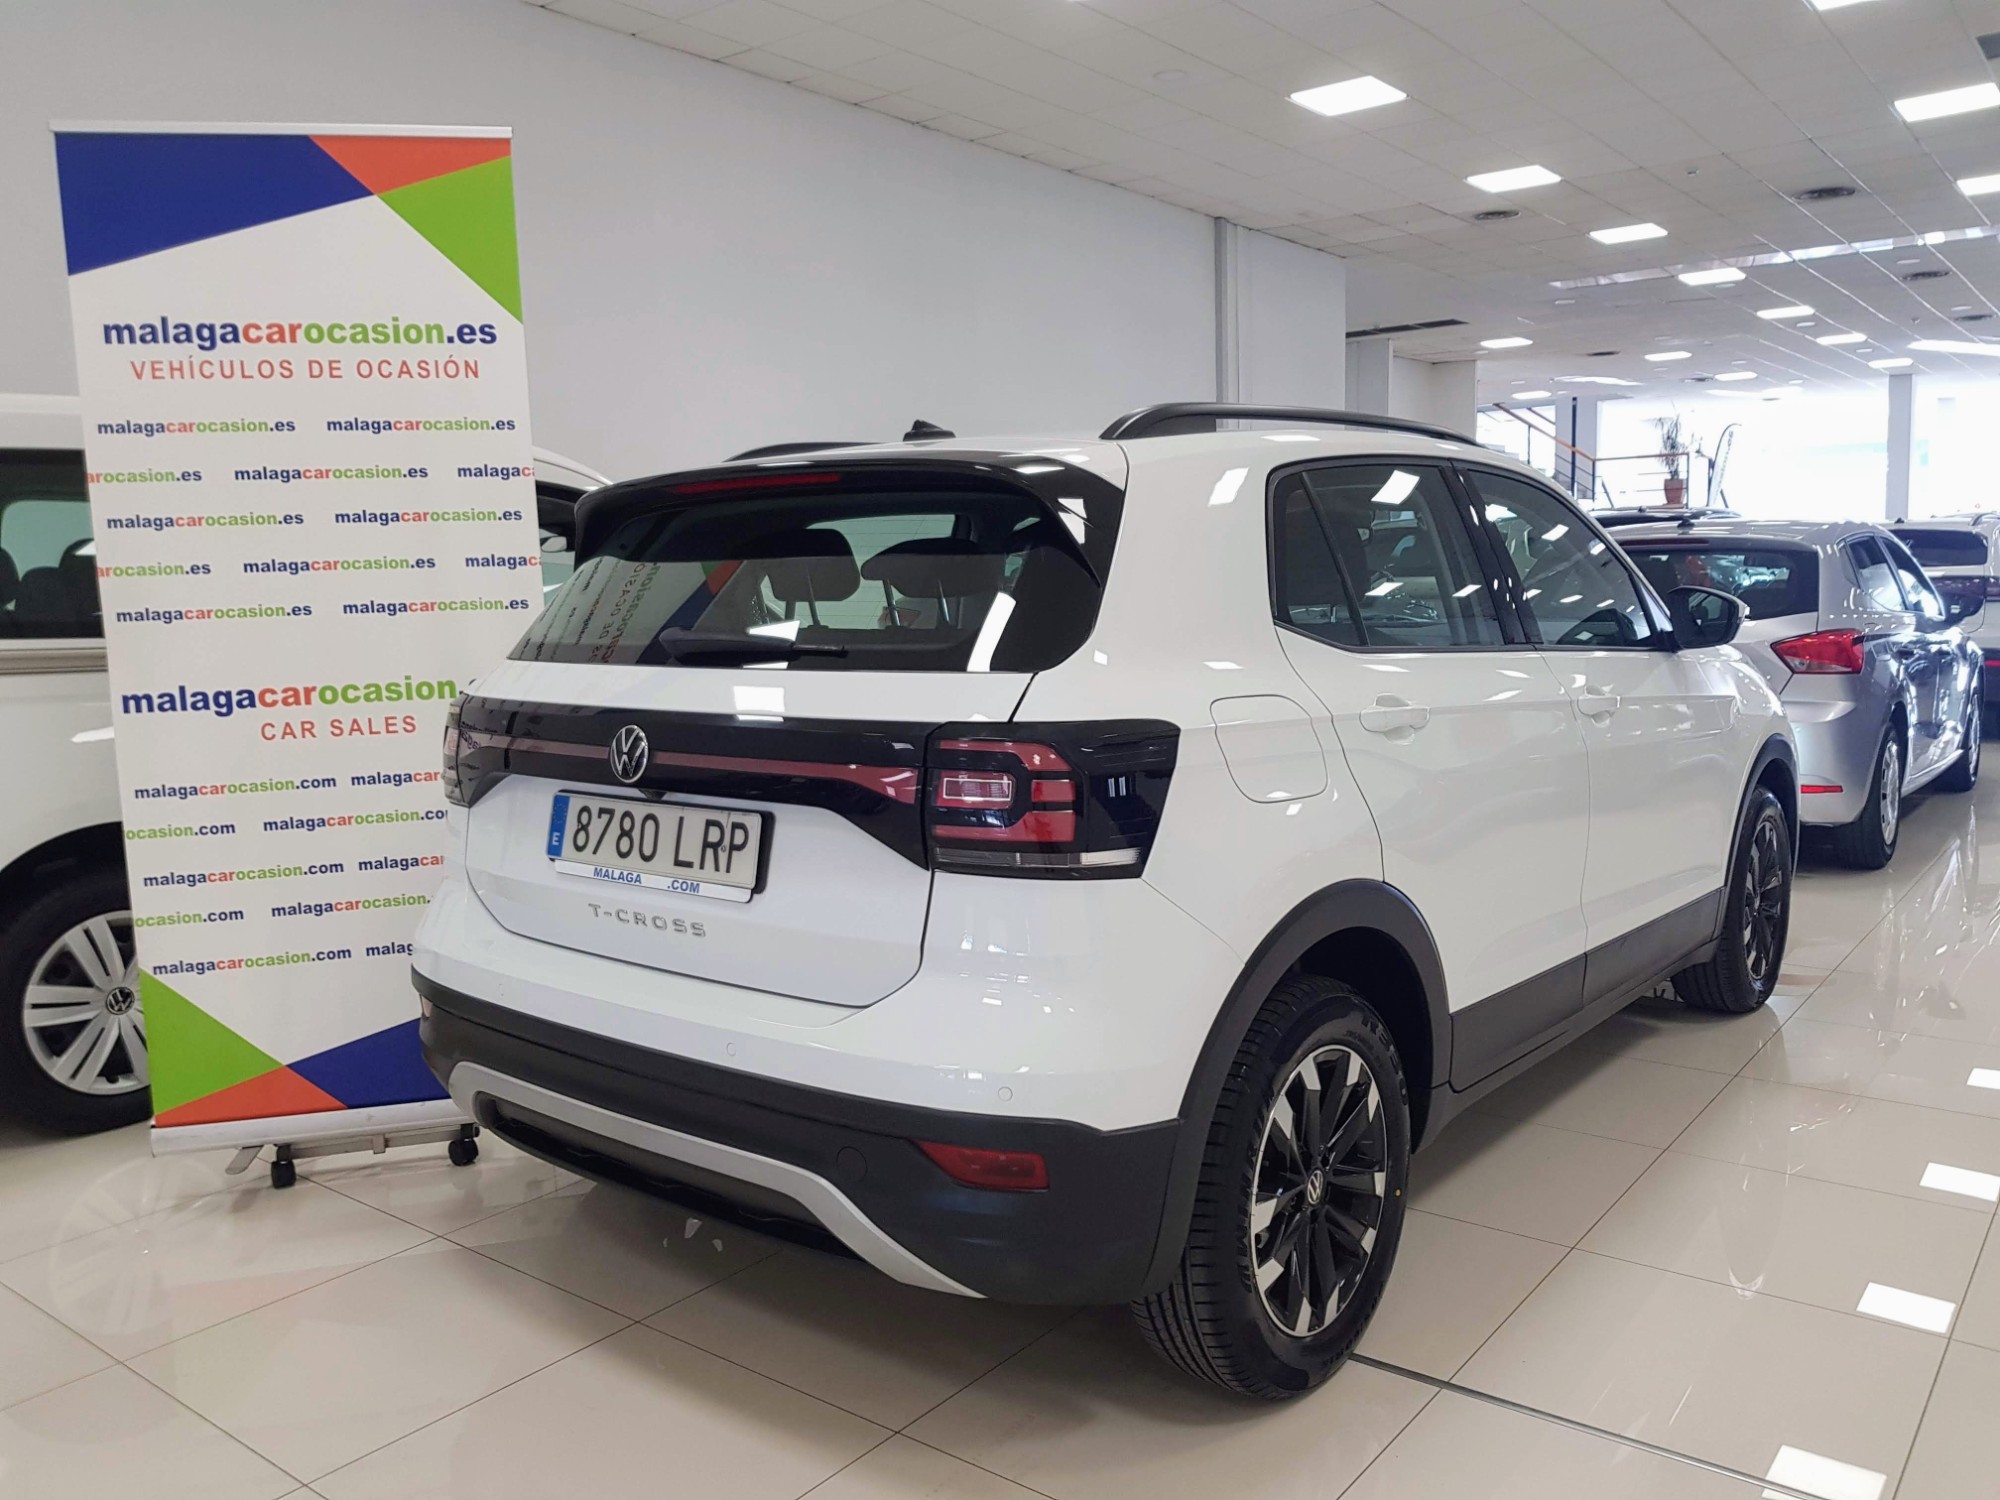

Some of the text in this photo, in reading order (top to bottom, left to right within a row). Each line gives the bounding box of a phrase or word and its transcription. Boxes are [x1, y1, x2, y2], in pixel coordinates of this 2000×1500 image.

[103, 315, 497, 351] malagacarocasion.es
[130, 354, 479, 380] VEHÍCULOS DE OCASIÓN
[97, 418, 296, 437] malagacarocasion.es
[327, 417, 515, 435] malagacarocasion.es
[234, 465, 428, 483] malagacarocasion.es
[457, 463, 534, 481] malagac
[107, 512, 304, 531] malagacarocasion.es
[335, 508, 522, 526] malagacarocasion.es
[243, 556, 436, 575] malagacarocasion.es
[116, 604, 312, 624] malagacarocasion.es
[343, 597, 529, 616] malagacarocasion.es
[261, 715, 416, 741] CAR SALES
[134, 778, 336, 800] malagacarocasion.com
[351, 771, 443, 787] malagacar
[263, 809, 448, 832] malagacarocasion.co
[126, 824, 236, 840] ocasion.com
[552, 805, 750, 874] E 8780 LRP
[143, 863, 344, 887] malagacarocasion.com
[593, 867, 700, 894] MALAGA .COM
[271, 893, 433, 917] malagacarocasion.
[135, 910, 244, 928] ocasion.com
[588, 903, 706, 938] T-CROSS
[152, 949, 352, 976] malagacarocasion.com
